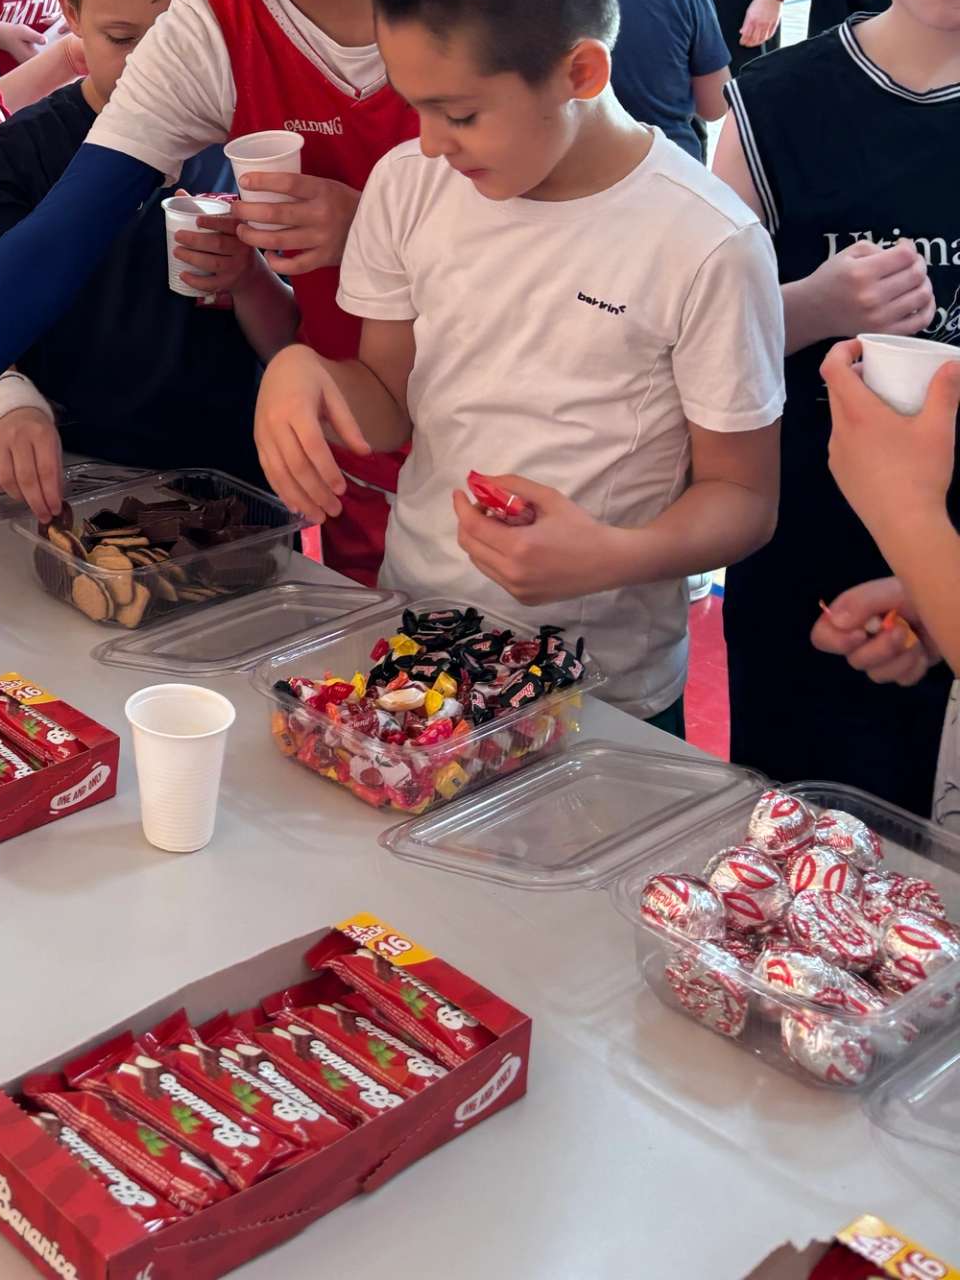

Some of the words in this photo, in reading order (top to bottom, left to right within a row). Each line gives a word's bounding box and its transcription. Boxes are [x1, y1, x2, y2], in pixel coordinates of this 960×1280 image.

[16, 686, 43, 699] 16
[56, 792, 72, 807] ONE
[72, 785, 88, 801] AND
[377, 935, 413, 957] 16
[310, 1039, 405, 1109] Bananica
[159, 1073, 261, 1148] Bananica
[59, 1126, 157, 1207] Bananica
